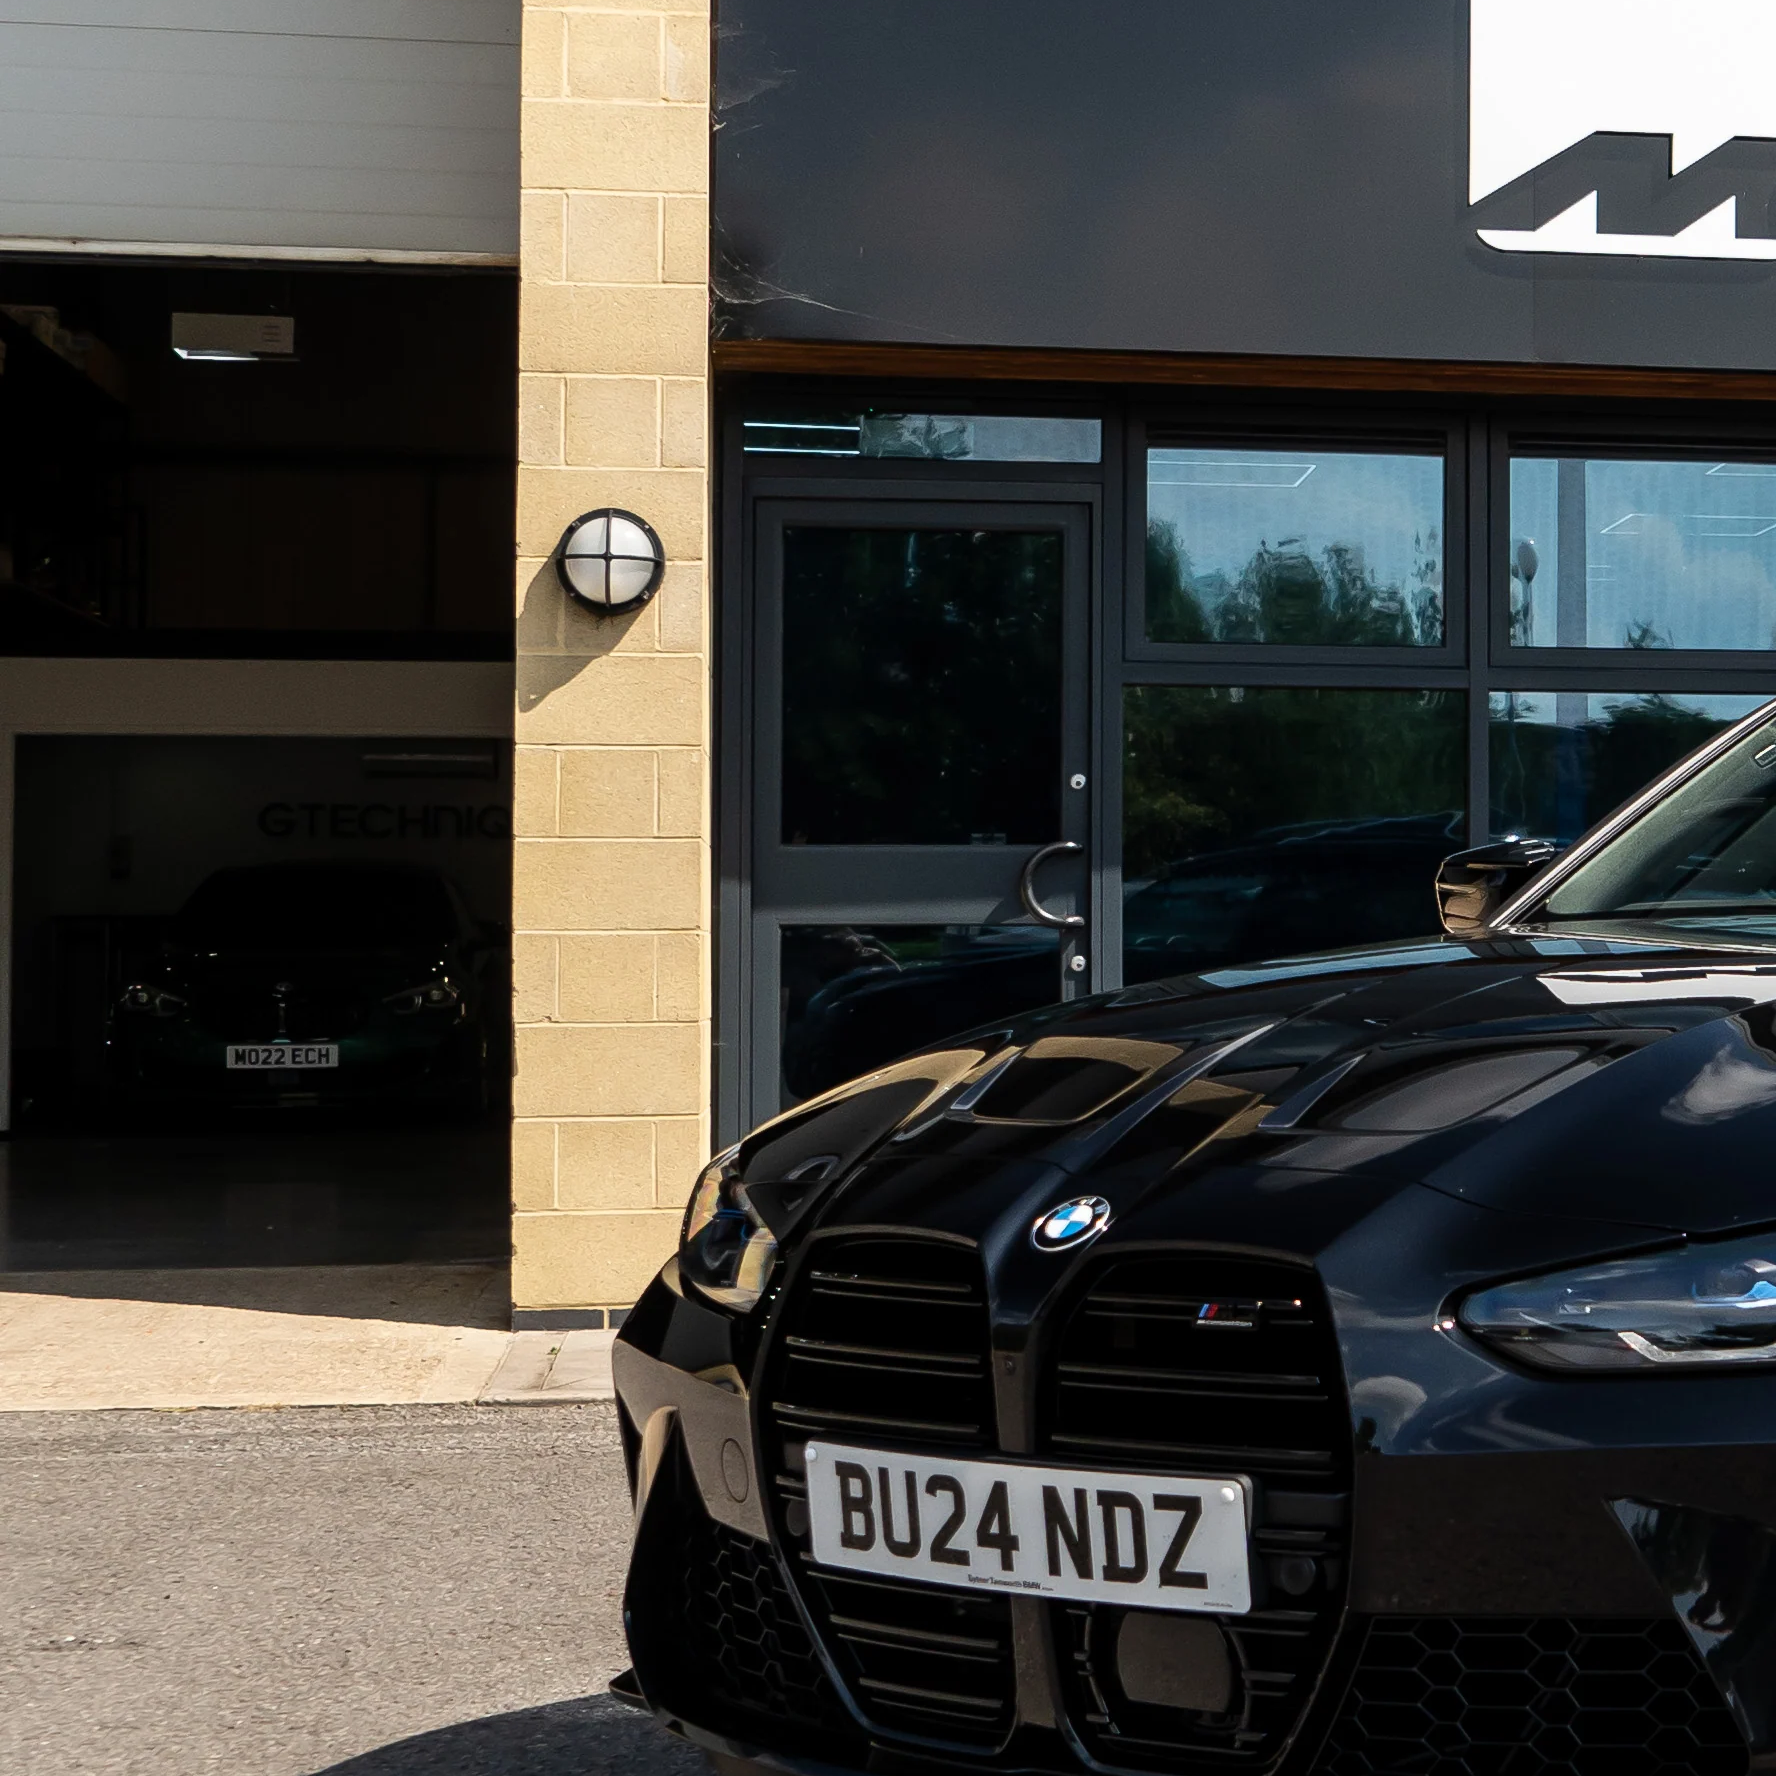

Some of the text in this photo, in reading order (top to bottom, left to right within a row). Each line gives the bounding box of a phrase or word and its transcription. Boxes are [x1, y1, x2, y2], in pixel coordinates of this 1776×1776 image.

[291, 1047, 330, 1065] ECH
[835, 1461, 1209, 1590] BU24 NDZ
